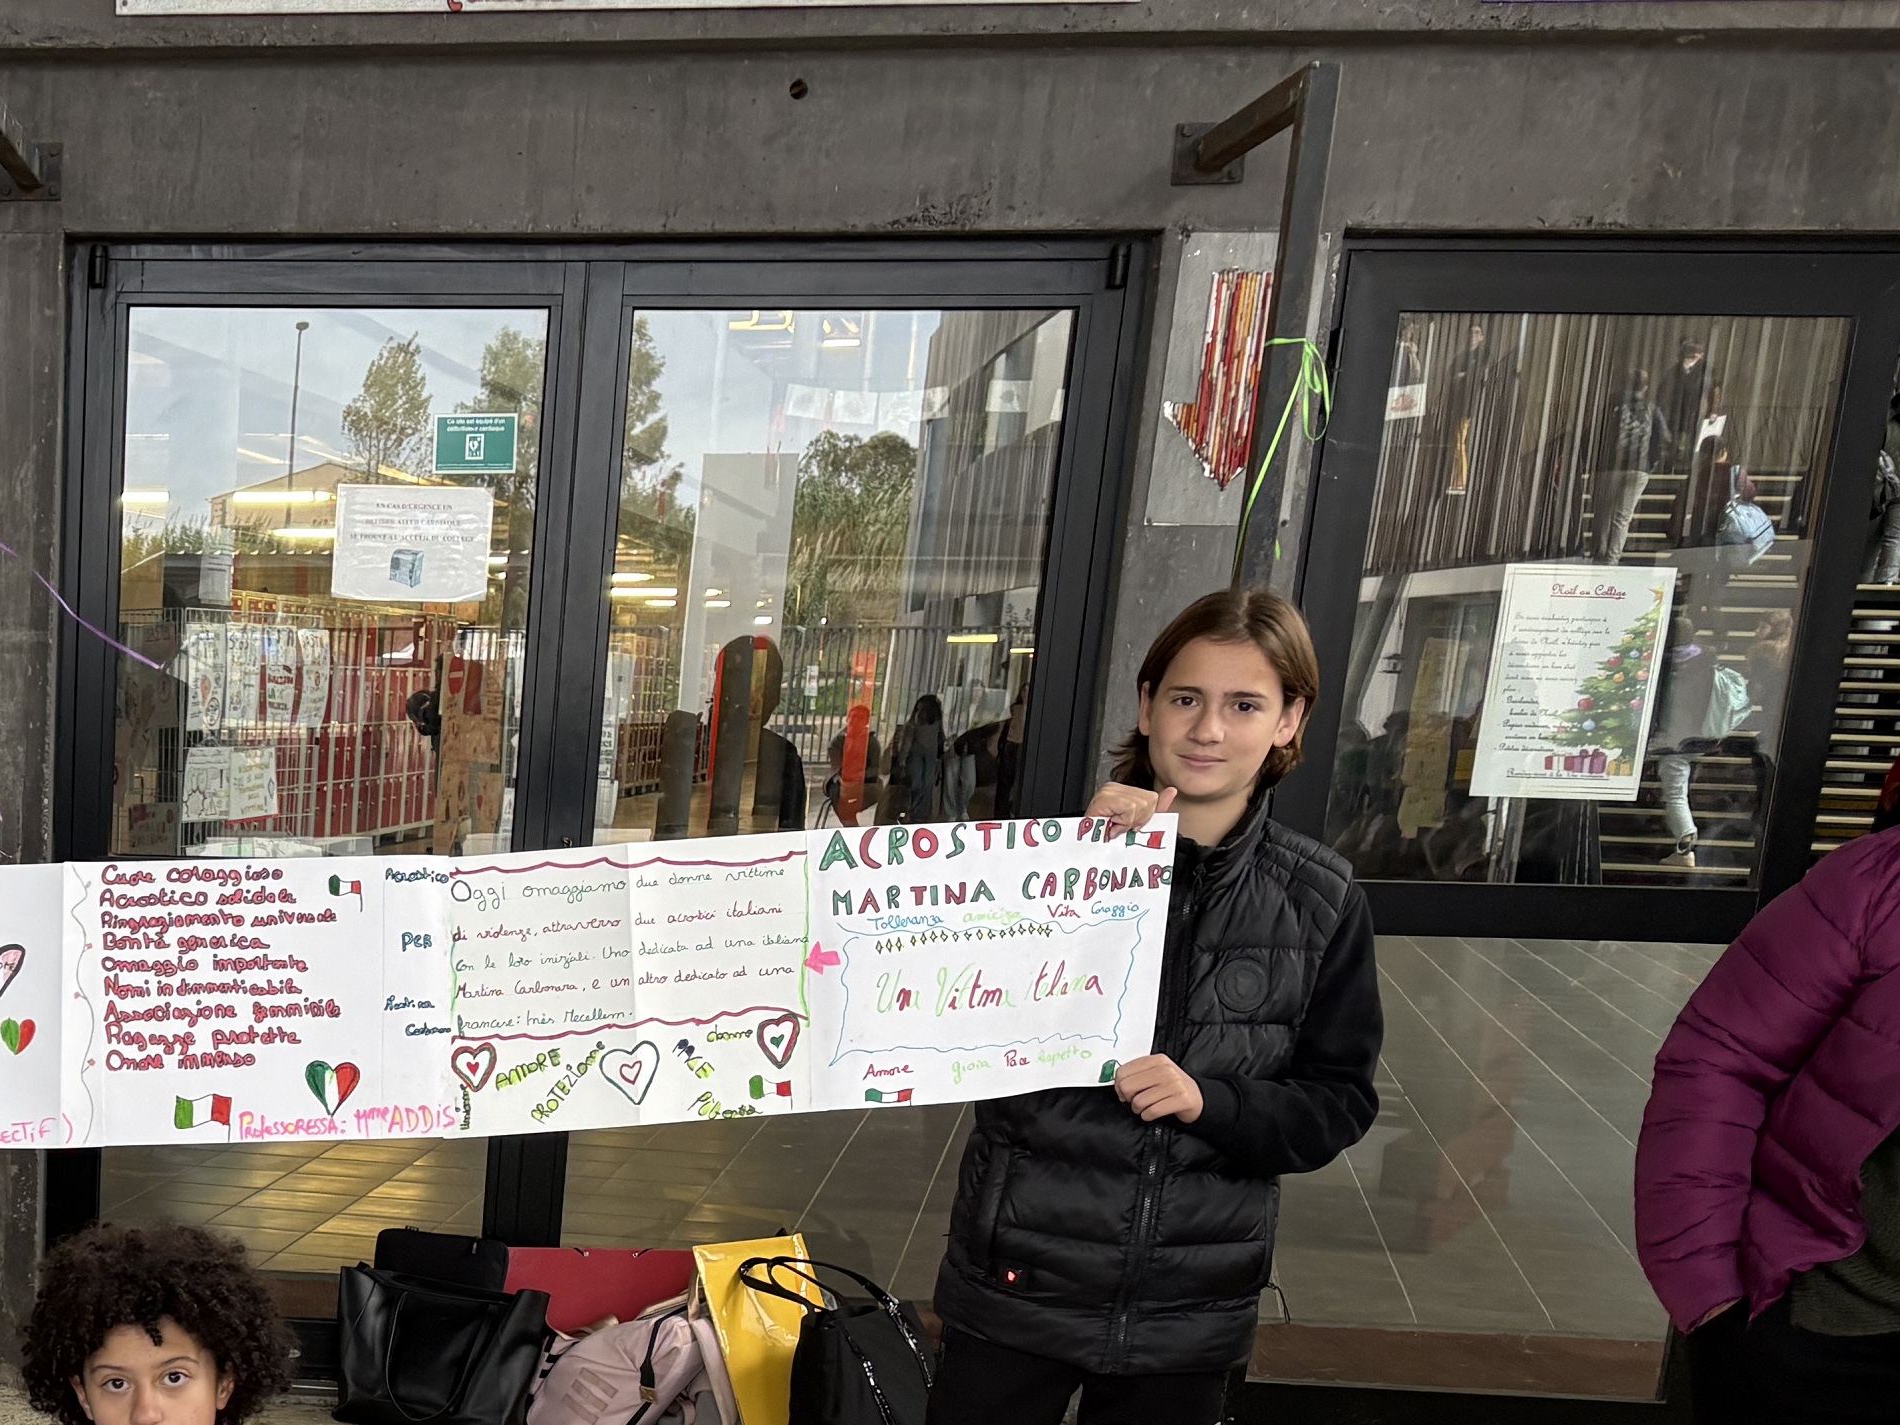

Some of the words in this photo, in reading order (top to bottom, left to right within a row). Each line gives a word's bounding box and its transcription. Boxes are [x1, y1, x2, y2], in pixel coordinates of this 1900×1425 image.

[819, 820, 1062, 872] ACROSTICO
[636, 877, 659, 889] due
[832, 879, 995, 915] MARTINA
[1022, 865, 1172, 900] CARBONARO
[863, 1063, 915, 1080] Amore
